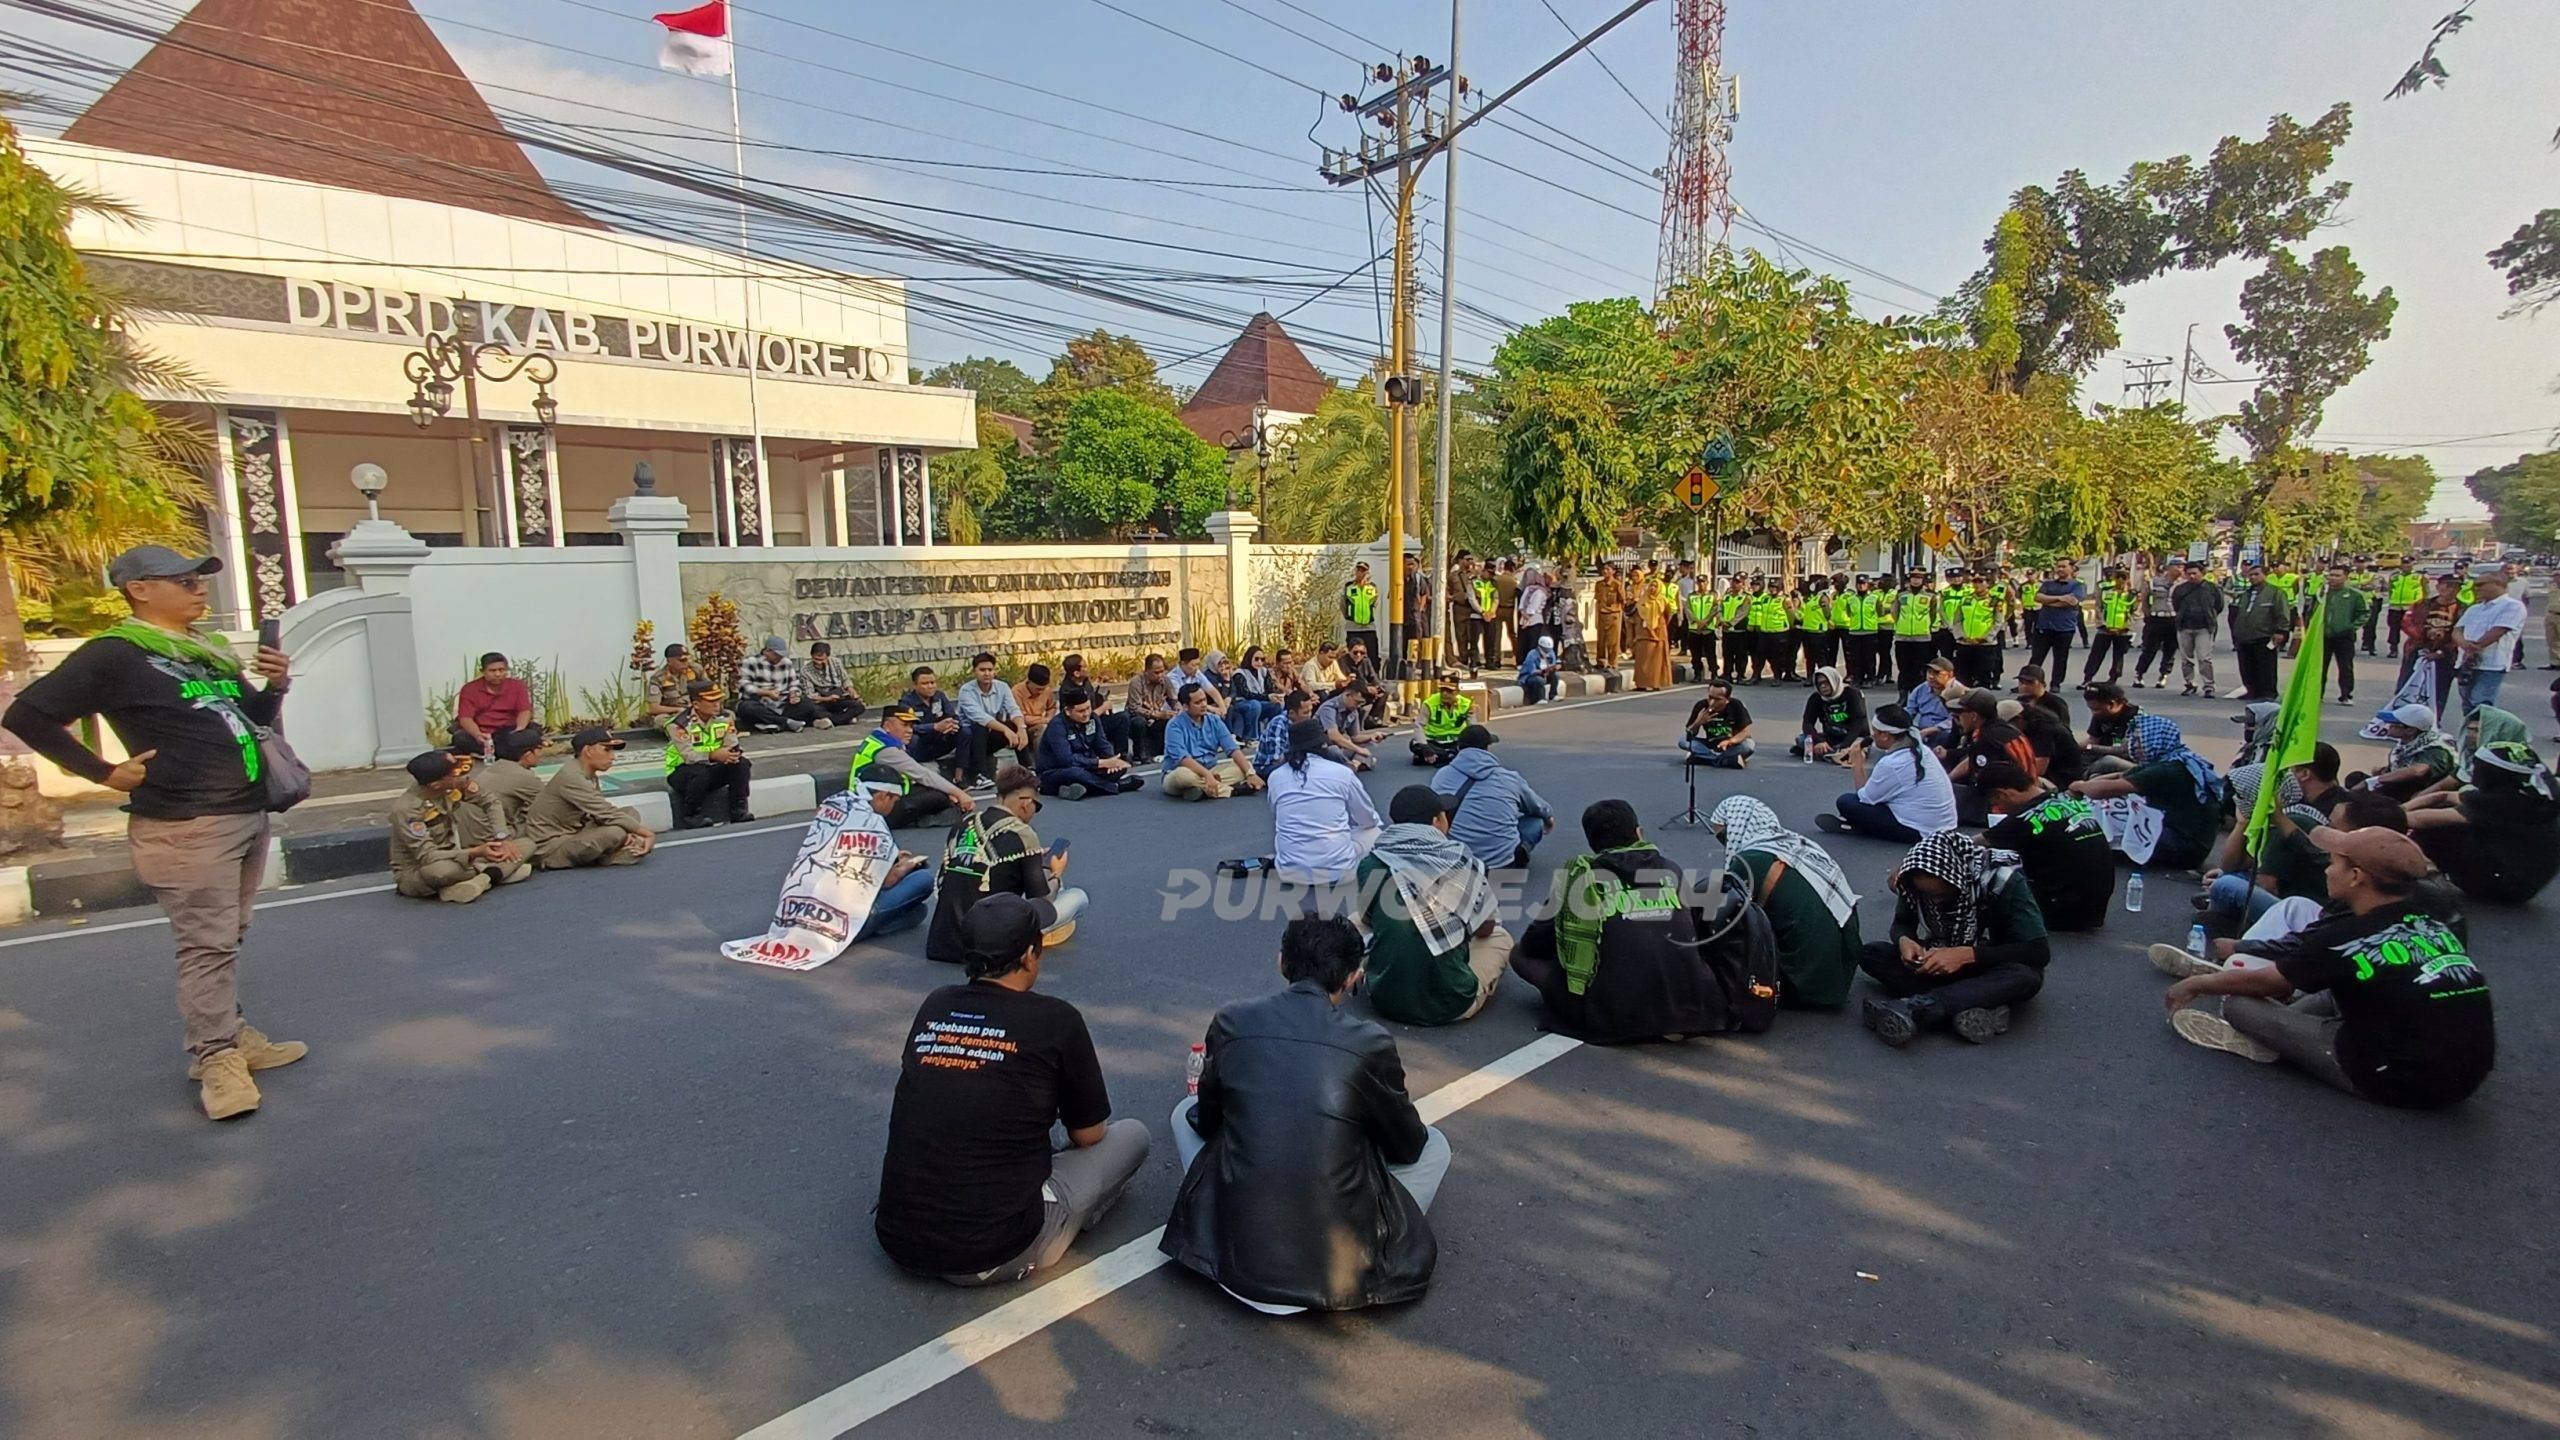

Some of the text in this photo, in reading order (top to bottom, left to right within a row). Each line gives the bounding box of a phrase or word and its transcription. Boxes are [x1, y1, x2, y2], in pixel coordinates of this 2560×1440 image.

[286, 277, 894, 383] DPRD KAB. PURWOREJO
[796, 577, 882, 598] DEWAN
[885, 574, 1021, 596] PERWAKILAN
[1024, 572, 1099, 591] RAKYAT
[796, 597, 1170, 641] KABUPATEN PURWOREJO
[1078, 631, 1181, 650] PURWOREJO
[787, 900, 834, 923] DPRD
[967, 1048, 1005, 1062] adalah
